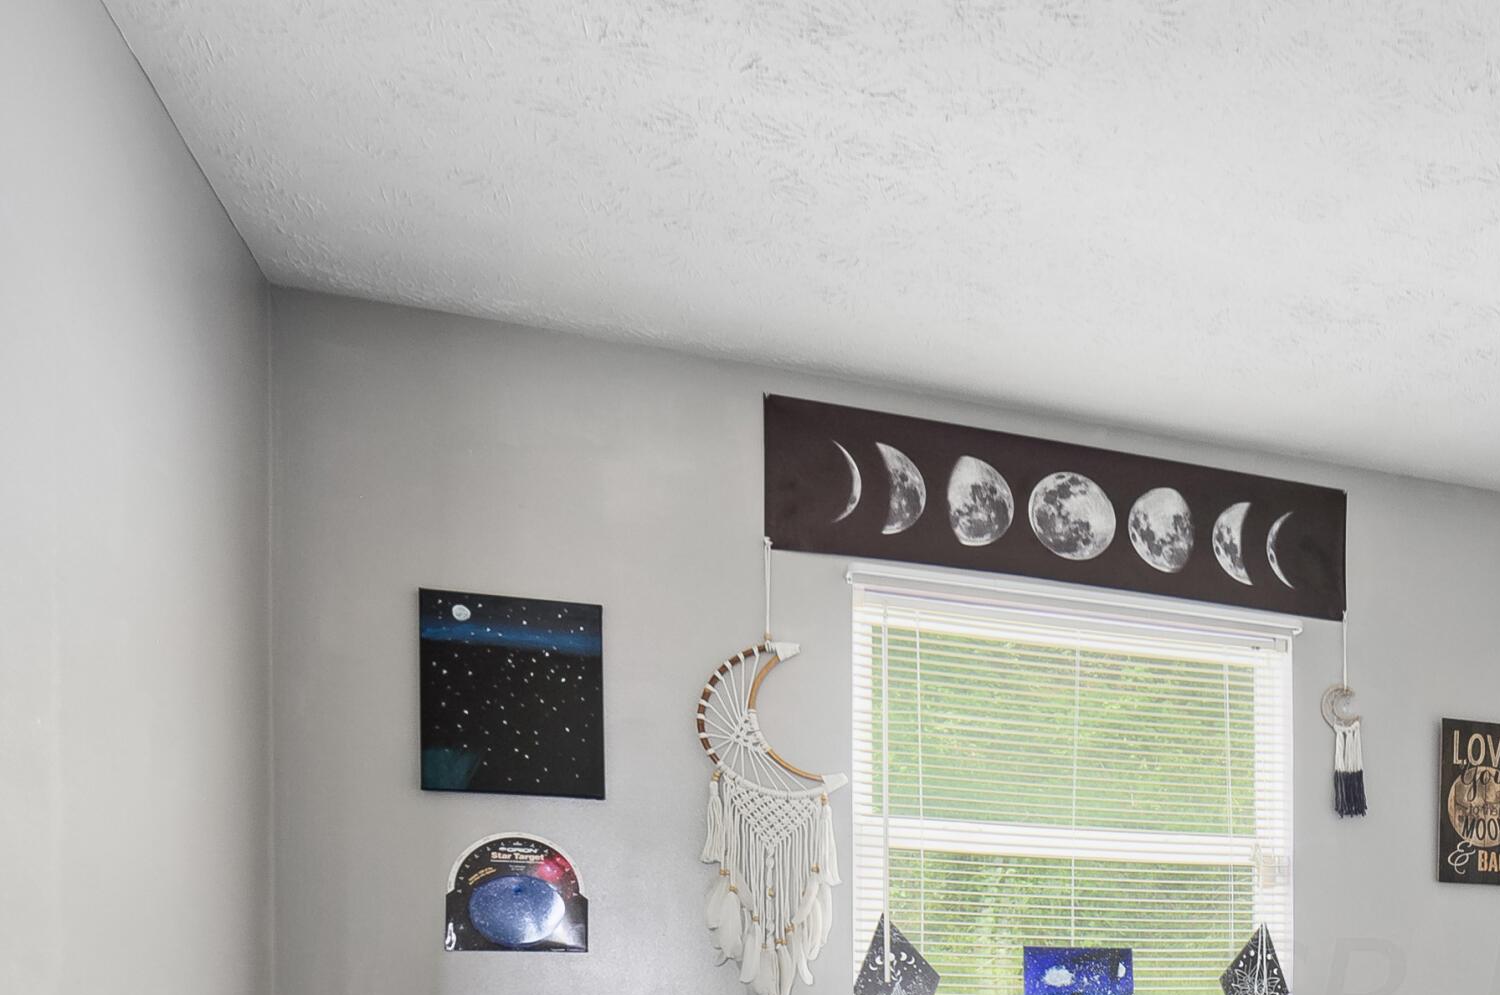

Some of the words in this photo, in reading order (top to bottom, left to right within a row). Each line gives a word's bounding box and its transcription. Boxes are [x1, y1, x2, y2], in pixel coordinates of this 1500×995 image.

[491, 851, 512, 860] Star
[513, 852, 545, 863] Target
[1447, 840, 1476, 875] &
